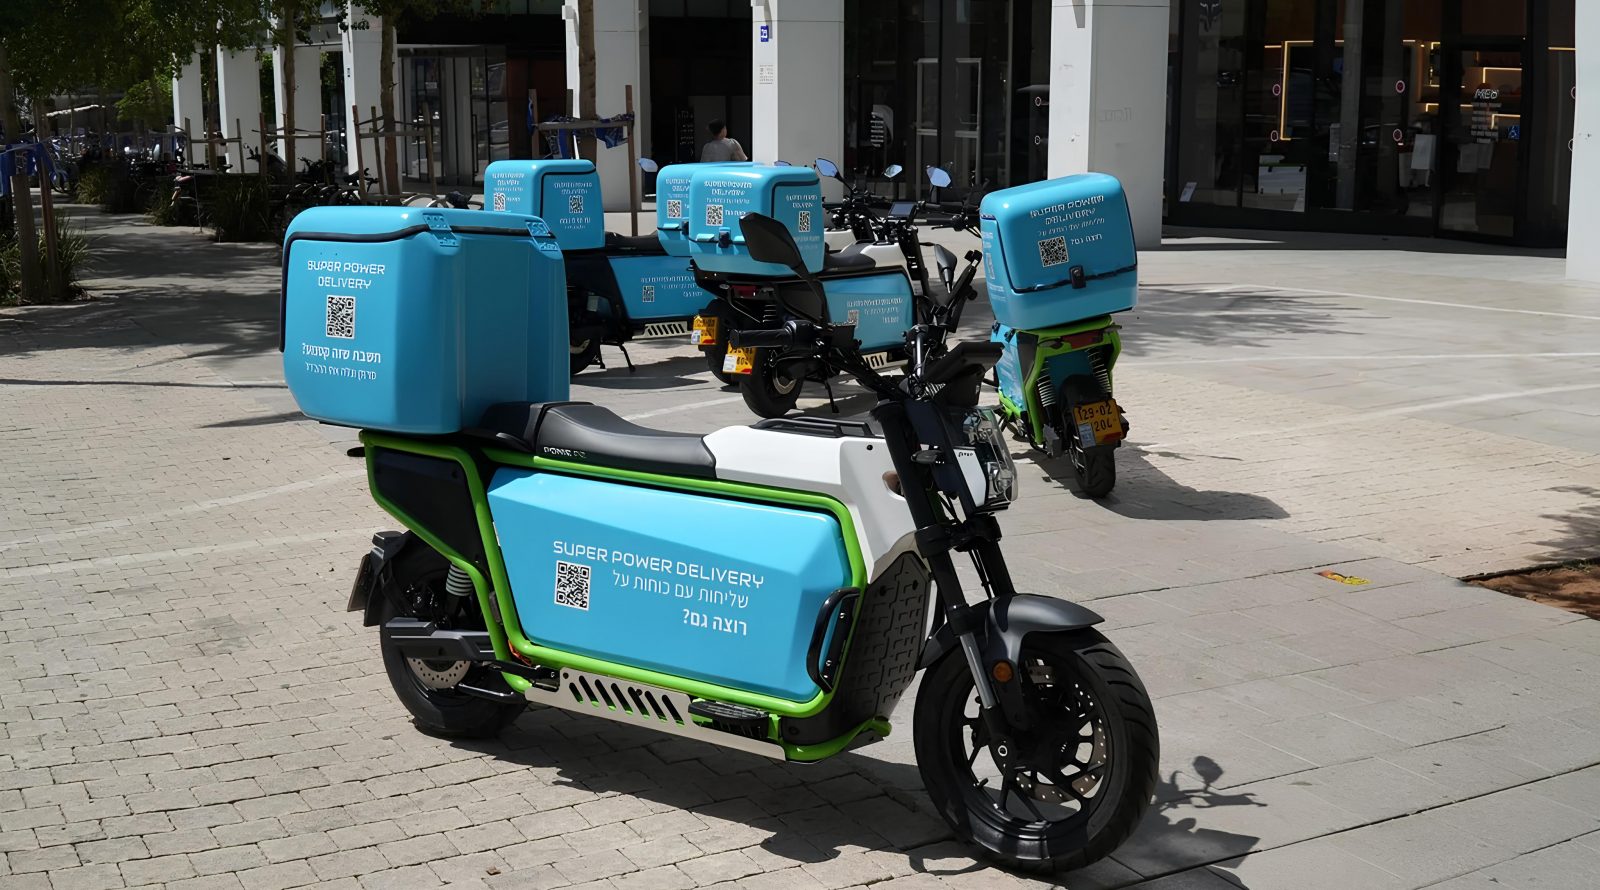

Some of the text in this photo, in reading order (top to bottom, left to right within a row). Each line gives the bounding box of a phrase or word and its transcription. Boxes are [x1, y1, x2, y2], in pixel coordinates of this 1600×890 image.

[307, 260, 385, 275] SUPER POWER
[318, 276, 372, 289] DELIVERY
[553, 540, 764, 589] SUPER POWER DELIVERY
[612, 569, 749, 609] שליחות עם כוחות על
[683, 608, 747, 636] רוצה גם?
